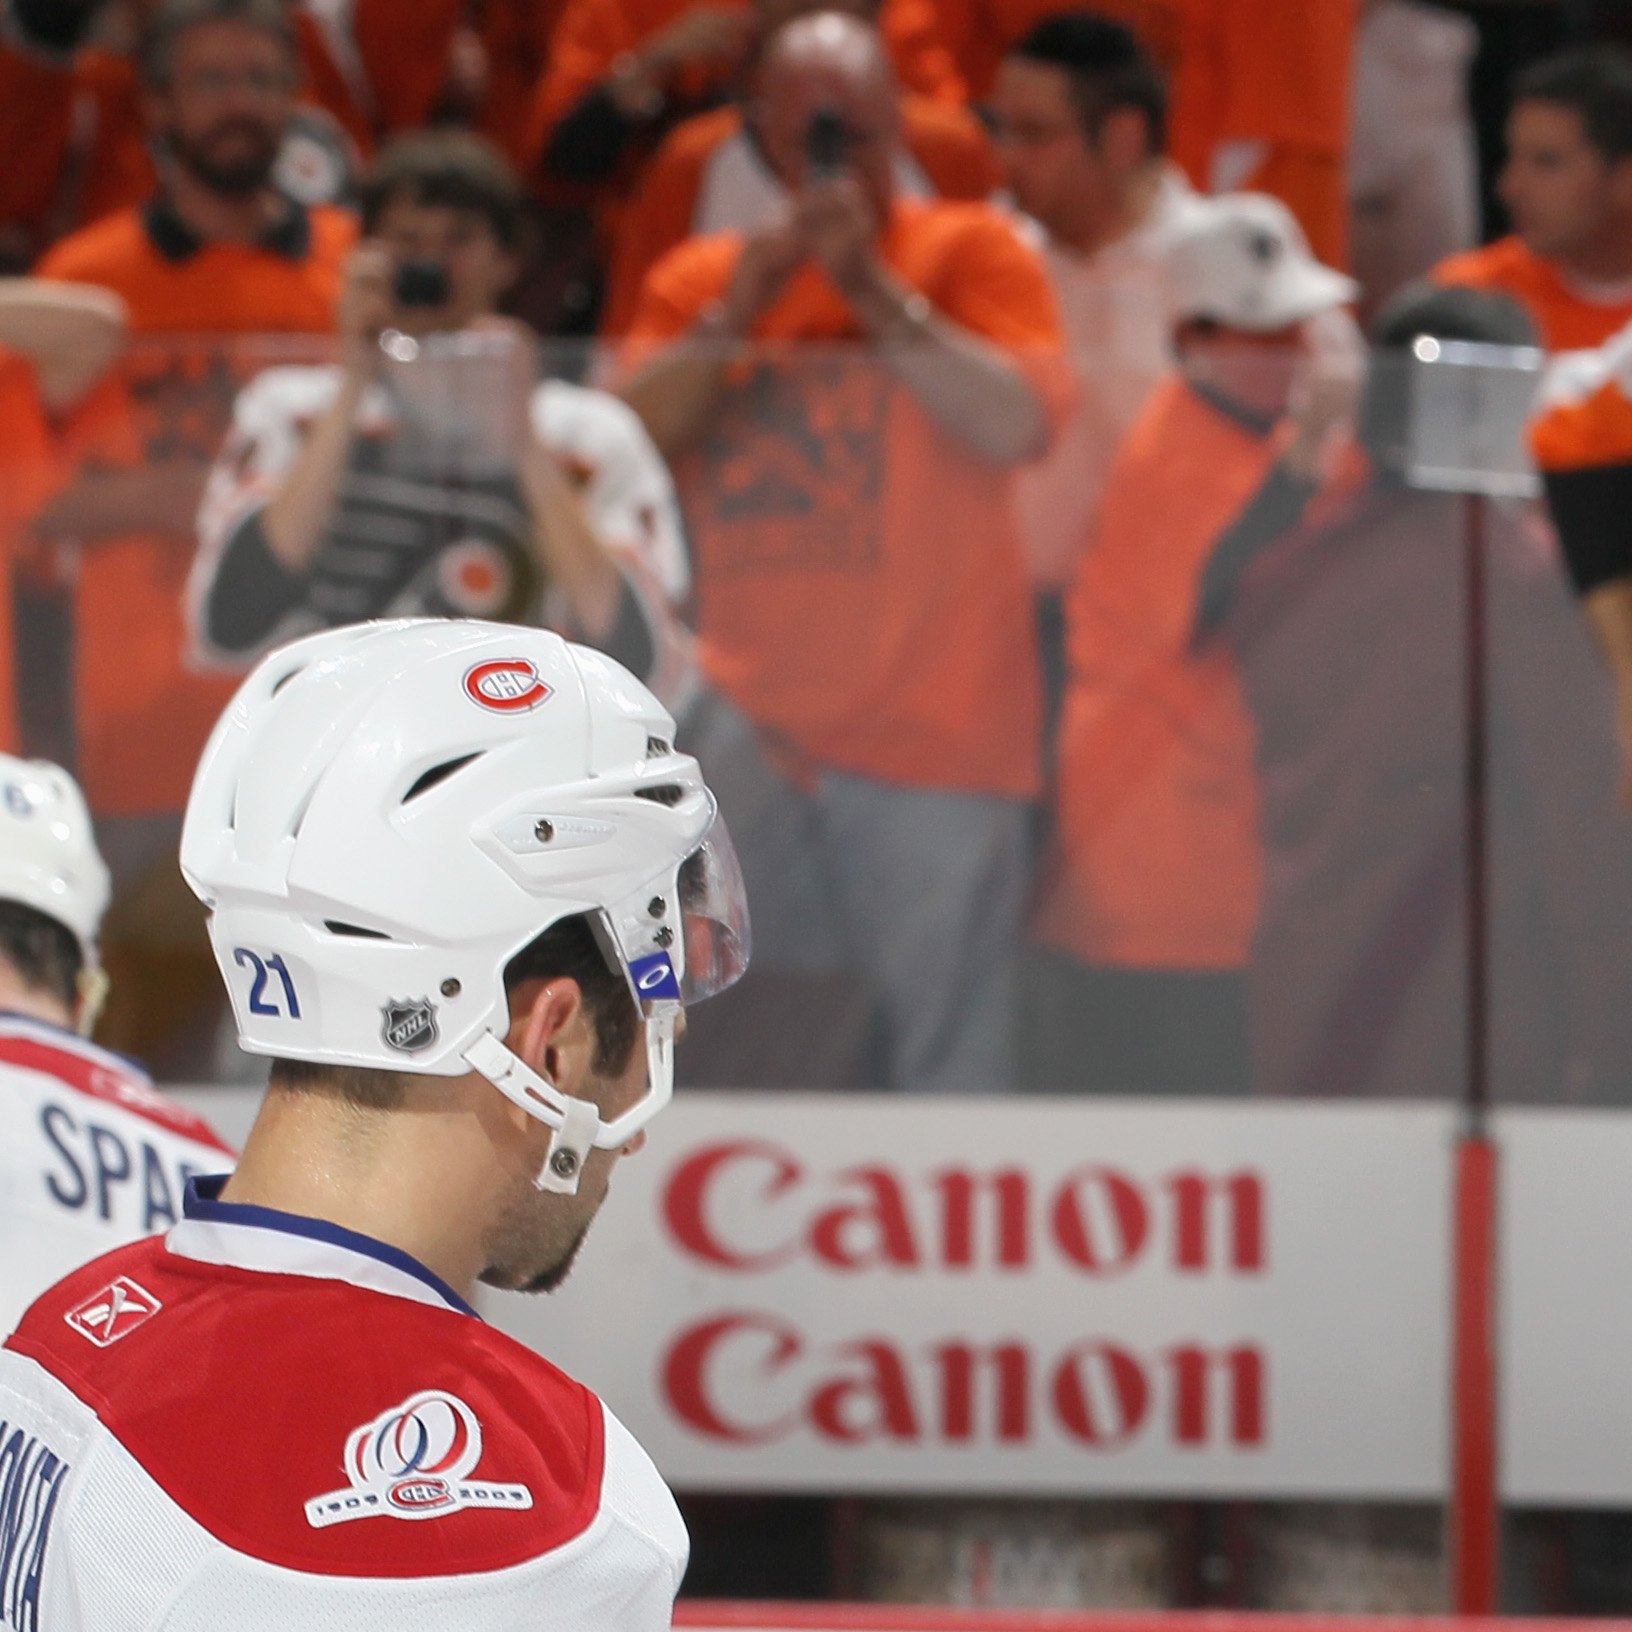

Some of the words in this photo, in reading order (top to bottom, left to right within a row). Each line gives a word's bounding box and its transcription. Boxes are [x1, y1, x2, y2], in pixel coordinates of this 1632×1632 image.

[233, 947, 302, 1018] 21
[41, 1104, 200, 1231] SPA
[658, 1136, 1268, 1277] Canon
[658, 1310, 1268, 1451] Canon
